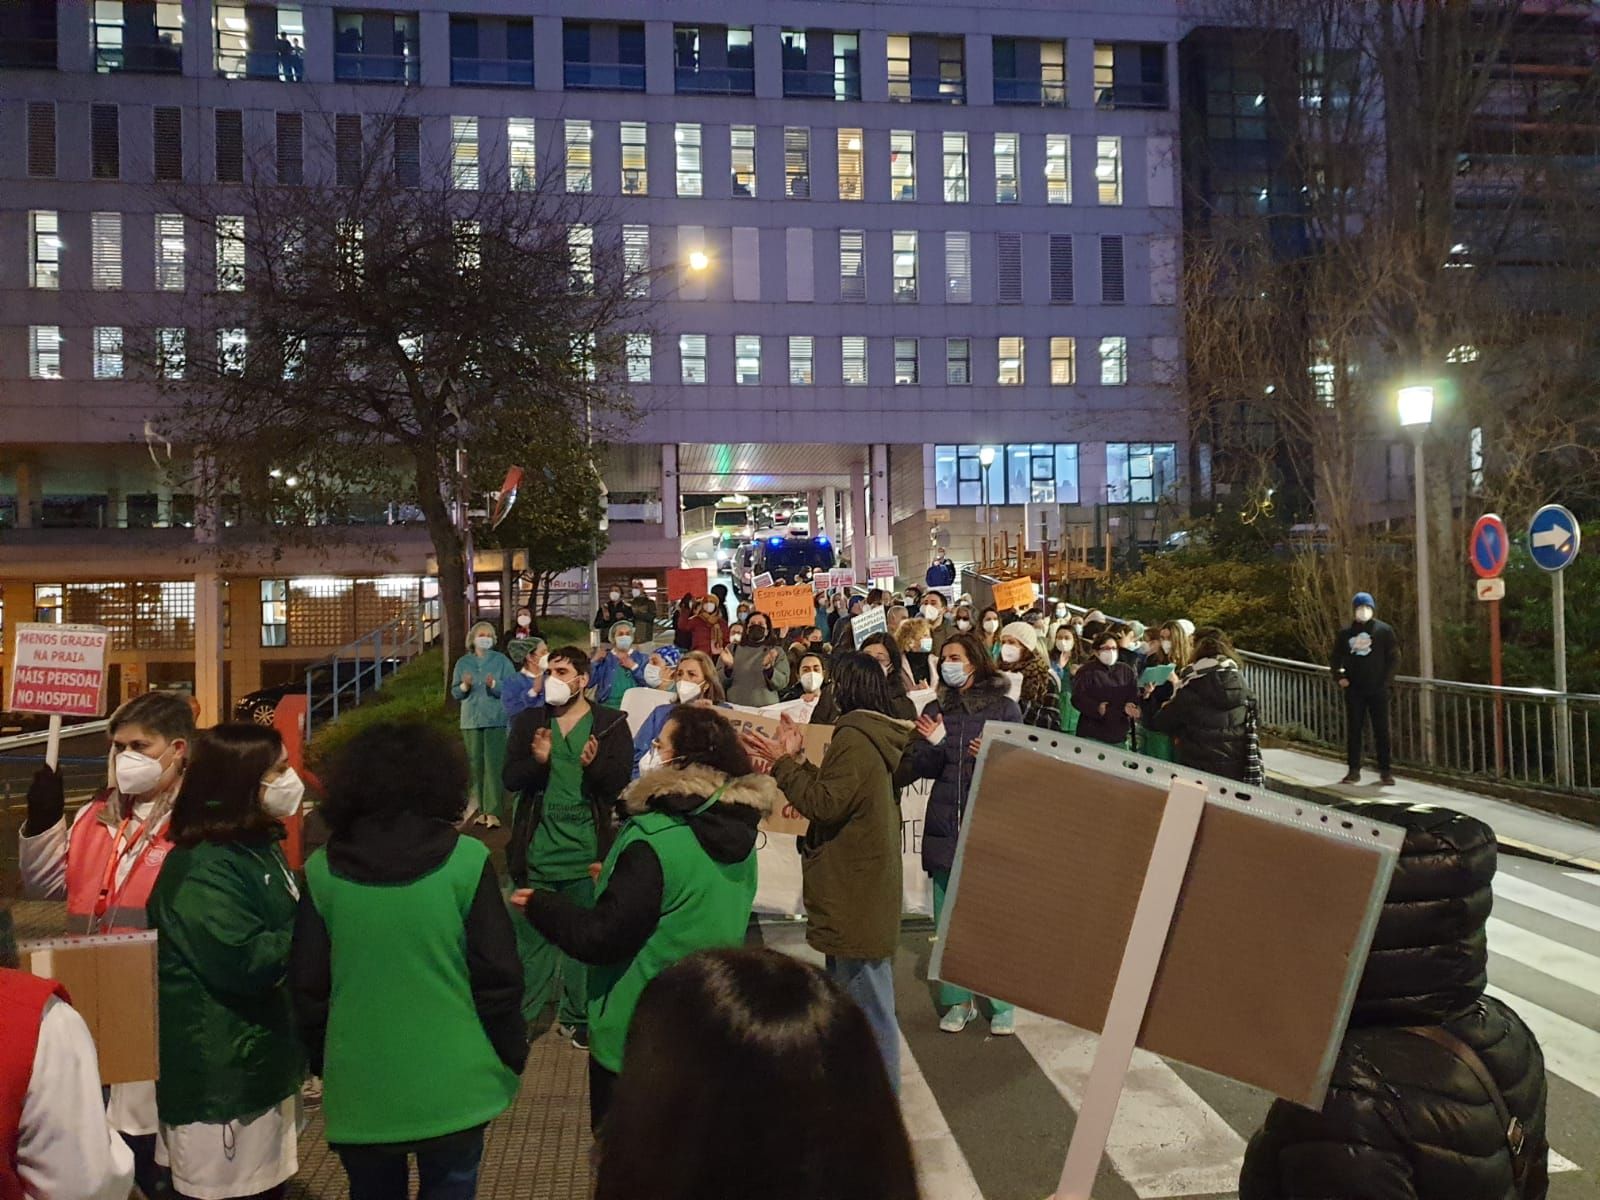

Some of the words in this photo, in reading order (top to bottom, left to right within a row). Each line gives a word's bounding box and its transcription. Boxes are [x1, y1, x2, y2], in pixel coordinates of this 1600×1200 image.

[20, 632, 58, 646] MENOS
[61, 634, 103, 648] GRAZAS
[33, 649, 48, 661] NA
[52, 650, 85, 663] PRAIA
[47, 671, 101, 688] PERSOAL
[16, 689, 34, 704] NO
[36, 691, 94, 708] HOSPITAL
